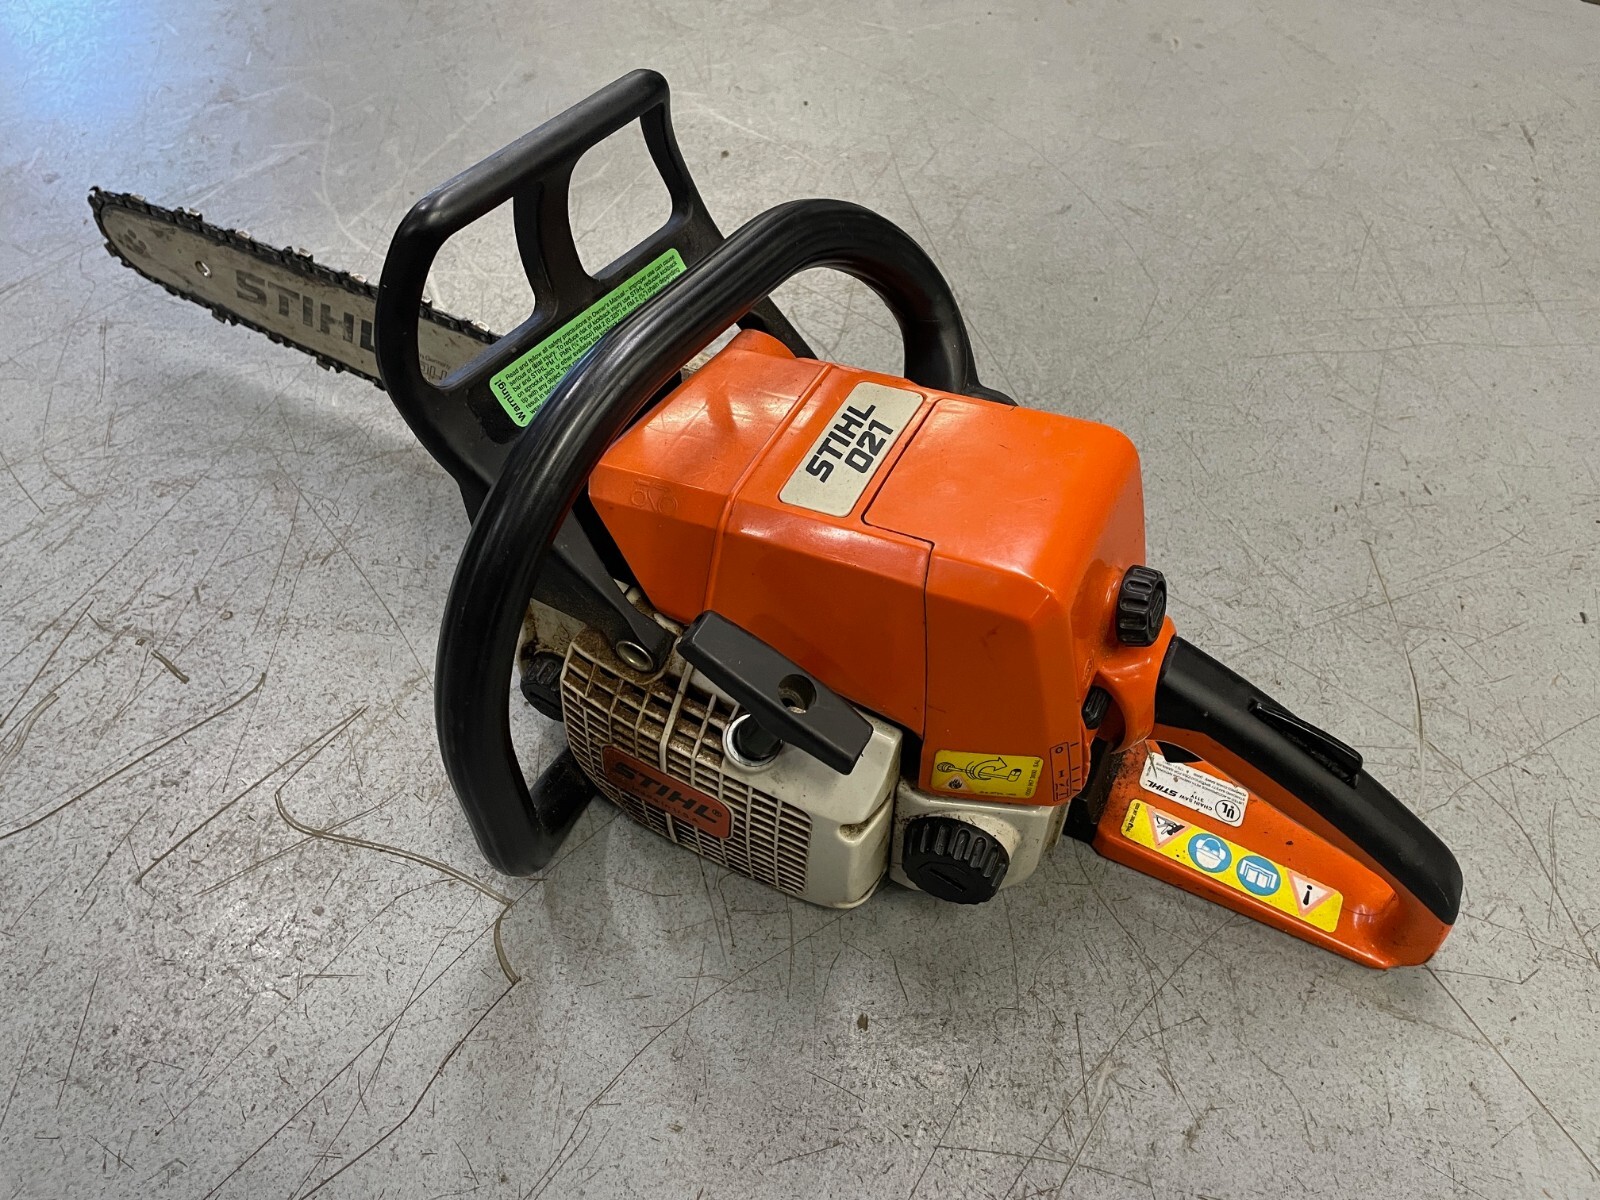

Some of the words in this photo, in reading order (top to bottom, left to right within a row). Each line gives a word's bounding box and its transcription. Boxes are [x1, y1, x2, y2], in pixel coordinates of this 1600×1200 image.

[234, 270, 375, 353] STIHL
[504, 367, 519, 380] Read
[518, 360, 528, 370] and
[527, 351, 542, 363] follow
[547, 336, 563, 350] safety
[561, 318, 588, 339] precautions
[608, 290, 625, 304] Manual
[646, 269, 654, 277] use
[662, 254, 675, 266] cause
[508, 370, 527, 386] serious
[556, 343, 564, 351] To
[562, 332, 579, 346] reduce
[629, 284, 644, 297] STIHL
[512, 383, 522, 392] bar
[520, 375, 532, 385] and
[530, 364, 546, 378] STIHL
[516, 390, 524, 398] on
[523, 375, 545, 394] sprocket
[527, 388, 538, 398] with
[537, 382, 548, 392] any
[494, 379, 526, 422] Warning!
[805, 404, 876, 483] STIHL
[844, 419, 894, 473] 021
[1147, 780, 1178, 797] STIHL
[1178, 794, 1192, 802] SAW
[1193, 800, 1212, 810] CHAIN
